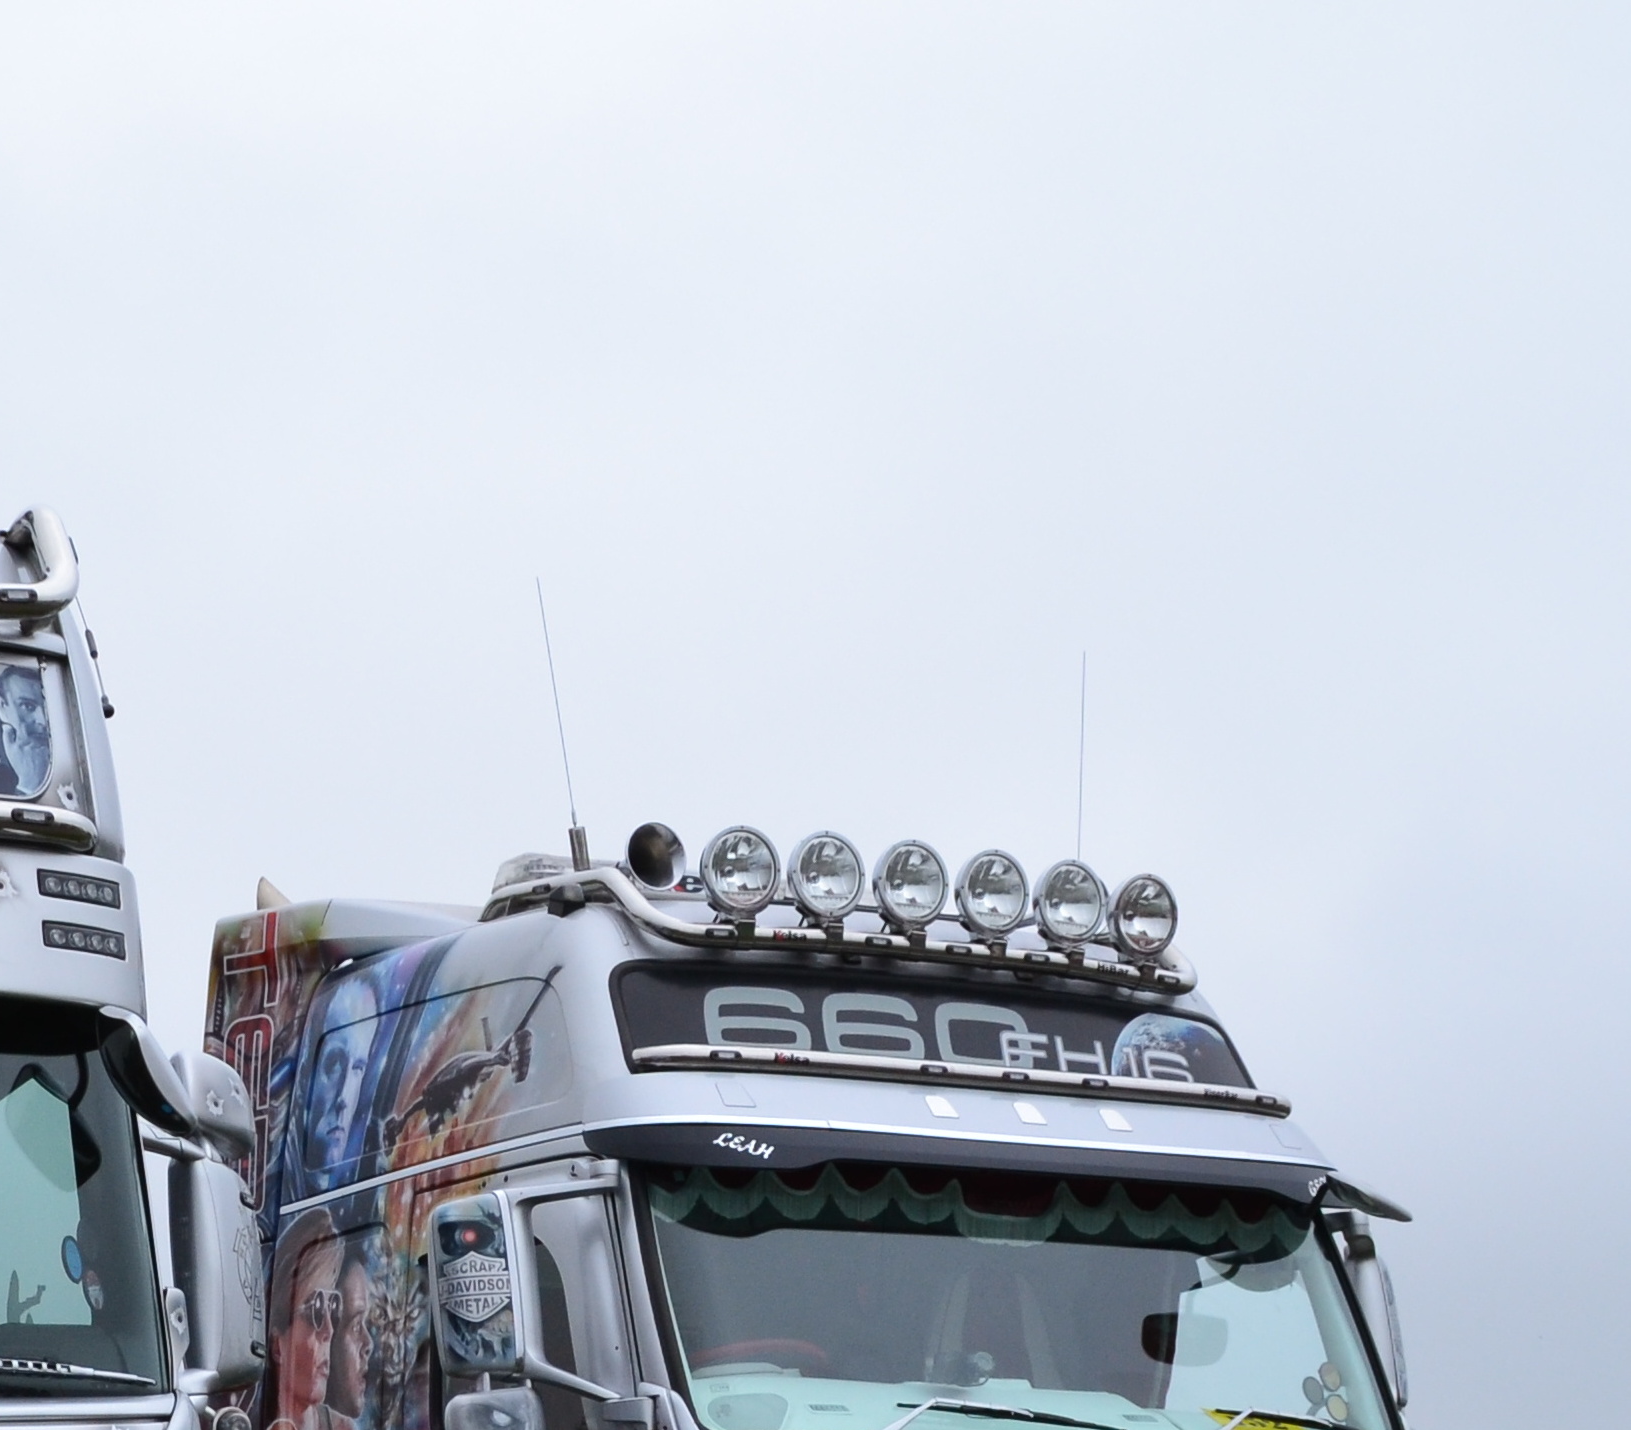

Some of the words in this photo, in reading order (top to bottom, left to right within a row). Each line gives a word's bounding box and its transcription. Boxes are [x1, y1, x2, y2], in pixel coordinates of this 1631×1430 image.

[773, 930, 807, 942] Kelsa
[704, 986, 1034, 1069] 660
[774, 1052, 810, 1066] Kelsa
[999, 1031, 1195, 1083] FH16
[451, 1259, 496, 1276] SCRAP
[454, 1296, 500, 1315] METAL
